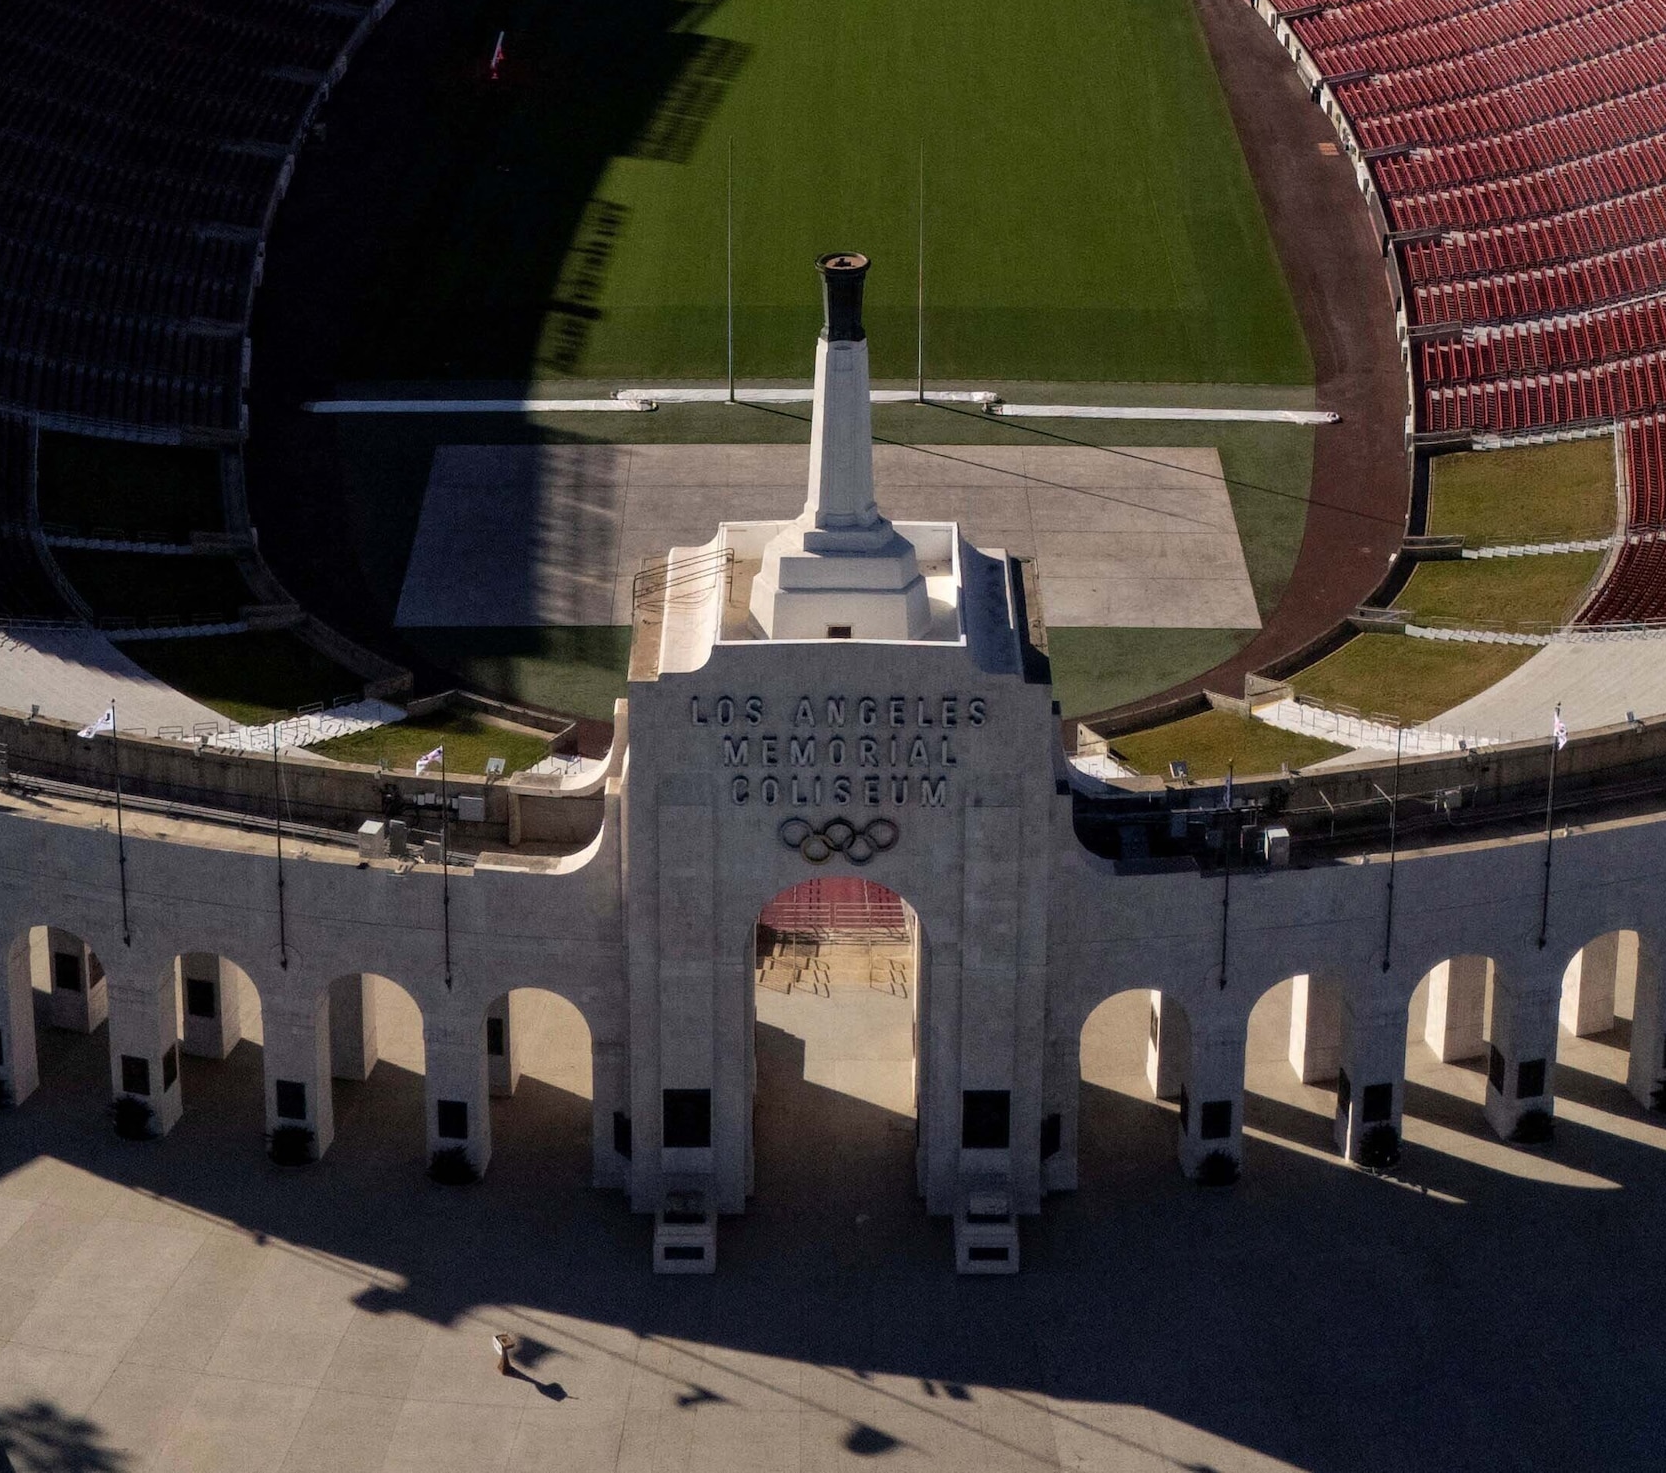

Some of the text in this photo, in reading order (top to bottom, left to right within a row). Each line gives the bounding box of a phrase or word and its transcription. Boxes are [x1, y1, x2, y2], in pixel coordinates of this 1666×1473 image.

[691, 695, 988, 728] LOS ANGELES
[722, 735, 958, 768] MEMORIAL
[732, 775, 949, 807] COLISEUM
